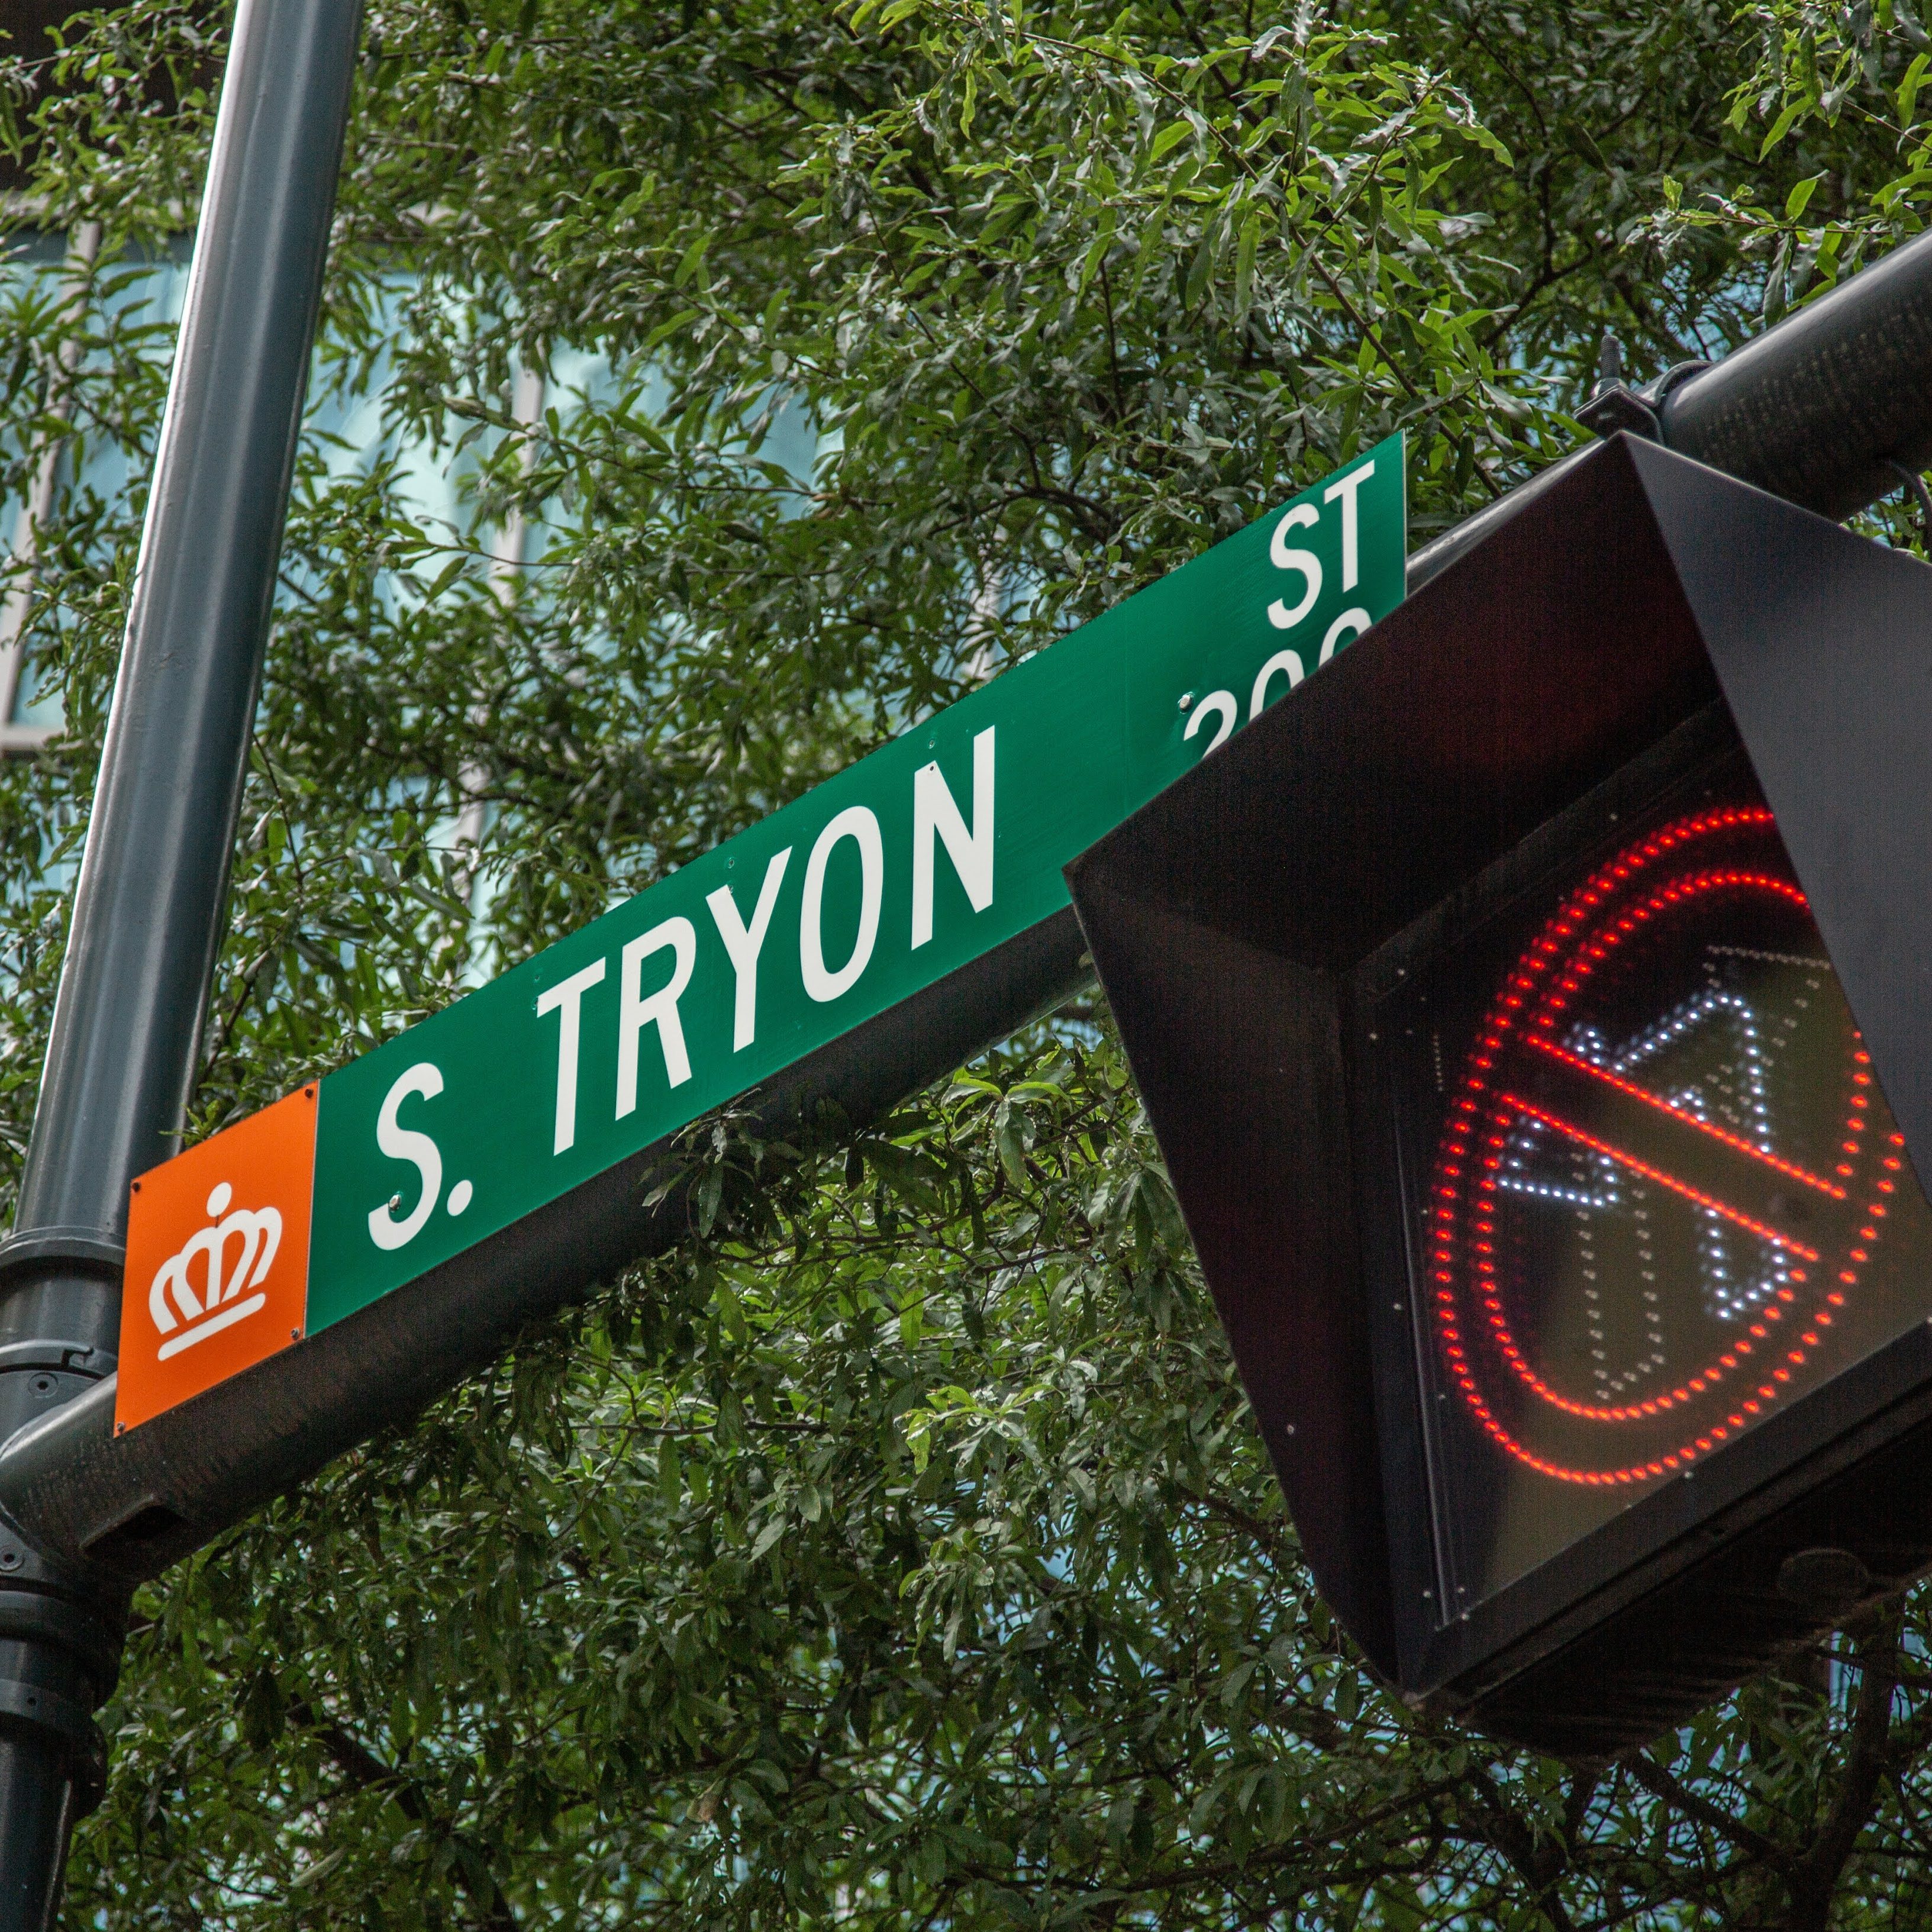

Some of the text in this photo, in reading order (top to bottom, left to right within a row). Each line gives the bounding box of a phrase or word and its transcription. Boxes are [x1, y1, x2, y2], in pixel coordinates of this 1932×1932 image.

[367, 459, 1376, 1251] S. TRYON ST
